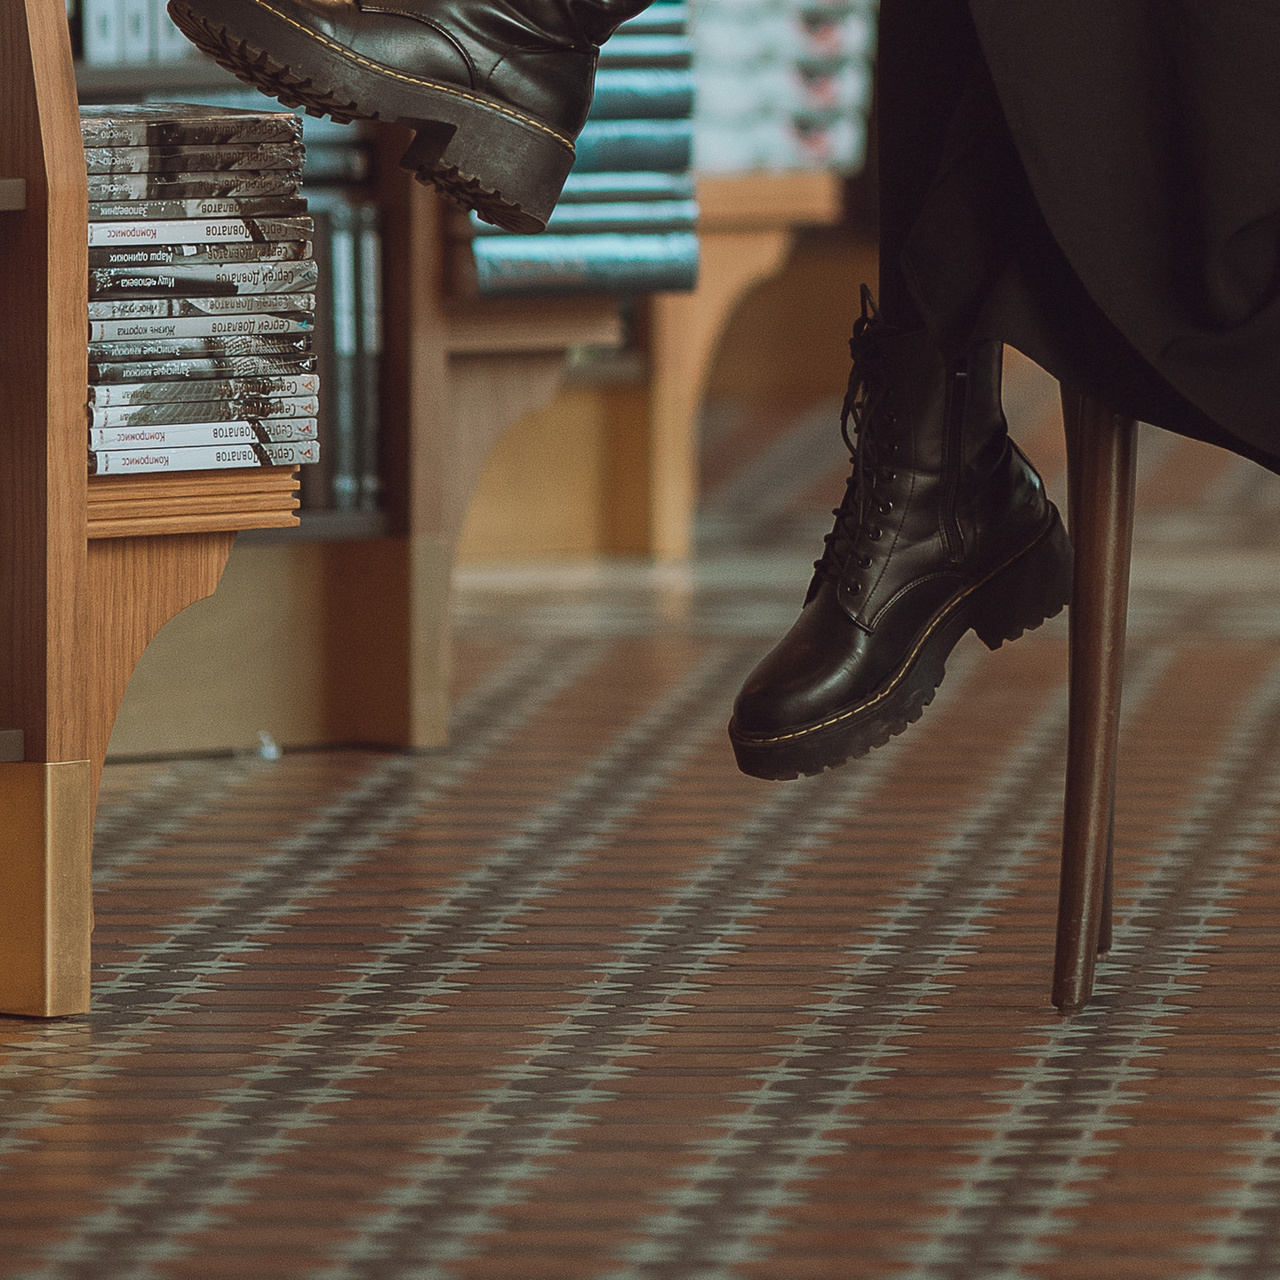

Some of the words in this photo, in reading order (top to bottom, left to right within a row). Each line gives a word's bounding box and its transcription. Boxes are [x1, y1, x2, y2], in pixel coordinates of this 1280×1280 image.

[101, 130, 133, 141] Ремесло
[102, 156, 135, 166] Ремесло
[101, 184, 133, 195] Ремесло
[100, 205, 148, 218] Заповедник
[201, 203, 240, 214] овлатов
[107, 227, 157, 240] Компромисс
[258, 224, 288, 238] Серге
[109, 252, 149, 263] одиноких
[150, 251, 173, 263] Марш
[257, 246, 288, 260] Сере
[120, 277, 157, 287] человека
[157, 275, 175, 288] Ищу
[215, 271, 260, 286] Довлатов
[260, 269, 294, 285] Сергей
[209, 297, 253, 311] Довлатов
[255, 296, 288, 310] Сергей
[117, 325, 148, 336] коротка
[150, 325, 176, 336] Жизнь
[212, 318, 256, 334] Довлатов
[257, 319, 290, 334] Сергей
[143, 345, 181, 357] Записные
[152, 366, 190, 378] Записные
[263, 379, 298, 395] Серге
[263, 401, 297, 417] Серге
[117, 430, 165, 443] Компромисс
[265, 423, 293, 439] Серге
[121, 454, 169, 467] Компромисс
[266, 447, 294, 462] Серге
